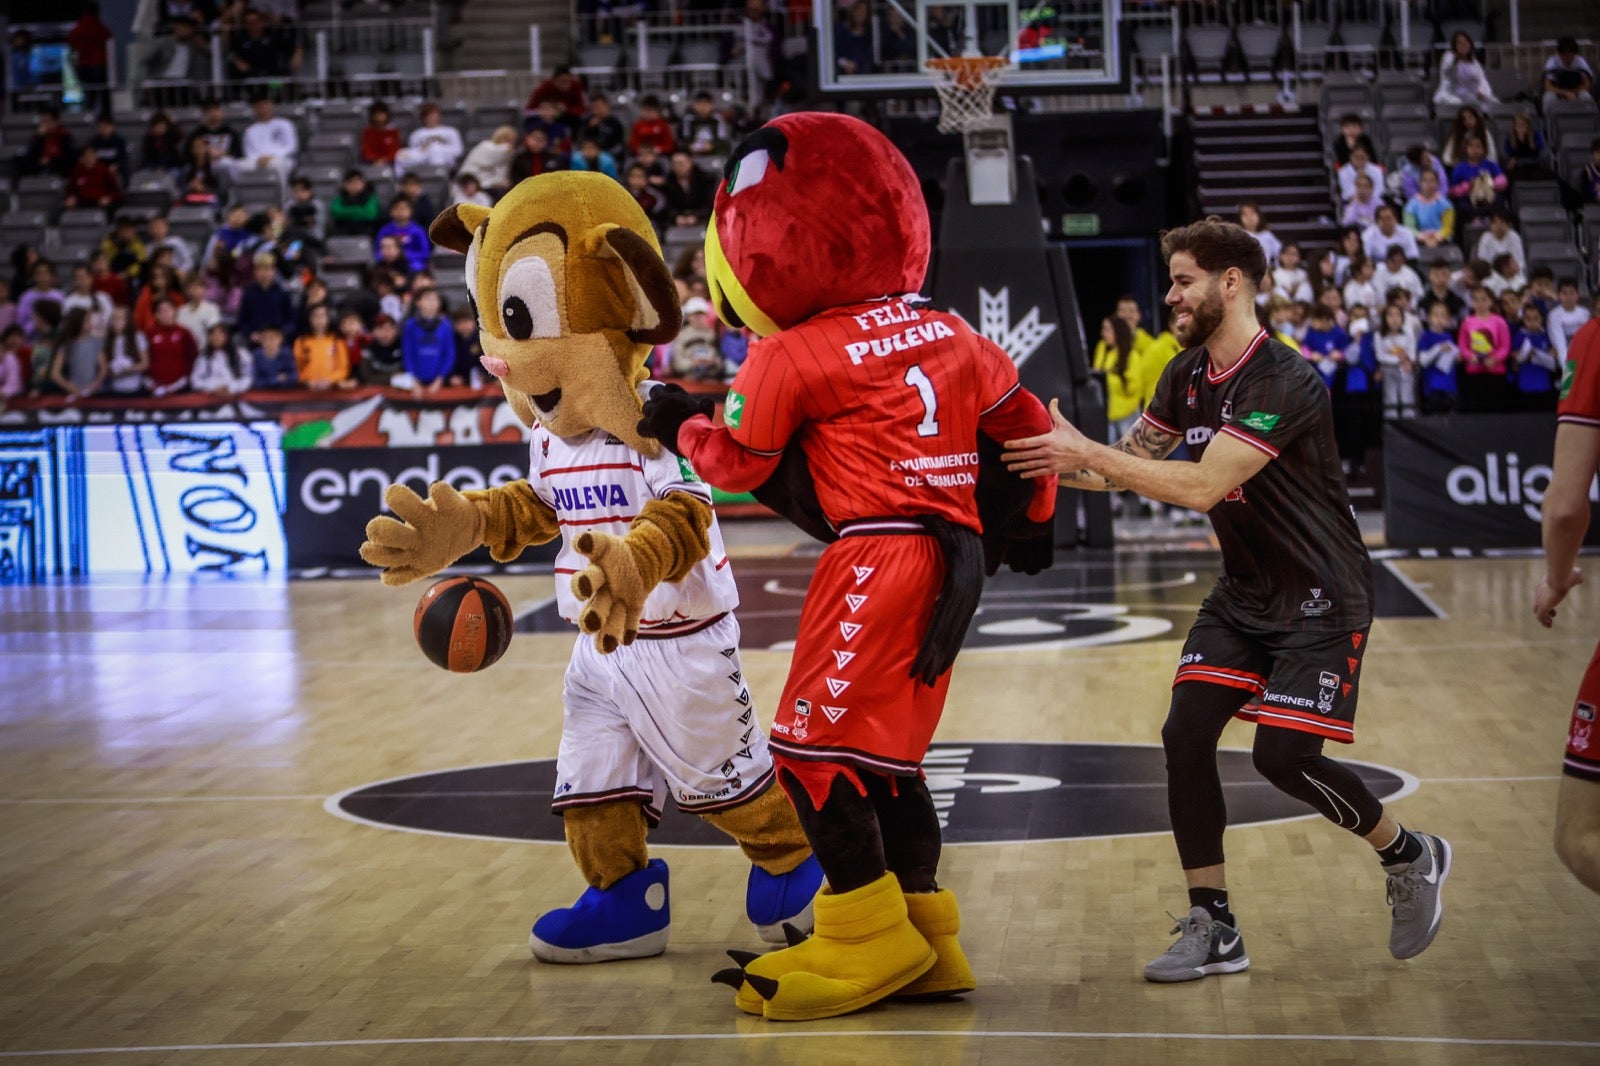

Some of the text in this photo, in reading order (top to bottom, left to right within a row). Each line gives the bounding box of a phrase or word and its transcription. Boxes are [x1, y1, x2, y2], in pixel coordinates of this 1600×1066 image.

[844, 320, 956, 366] PULEVA
[904, 364, 939, 438] 1
[301, 453, 531, 515] ende
[890, 452, 979, 471] AYUNTMIENTO
[1446, 452, 1600, 522] alig
[1268, 693, 1315, 709] BERNER
